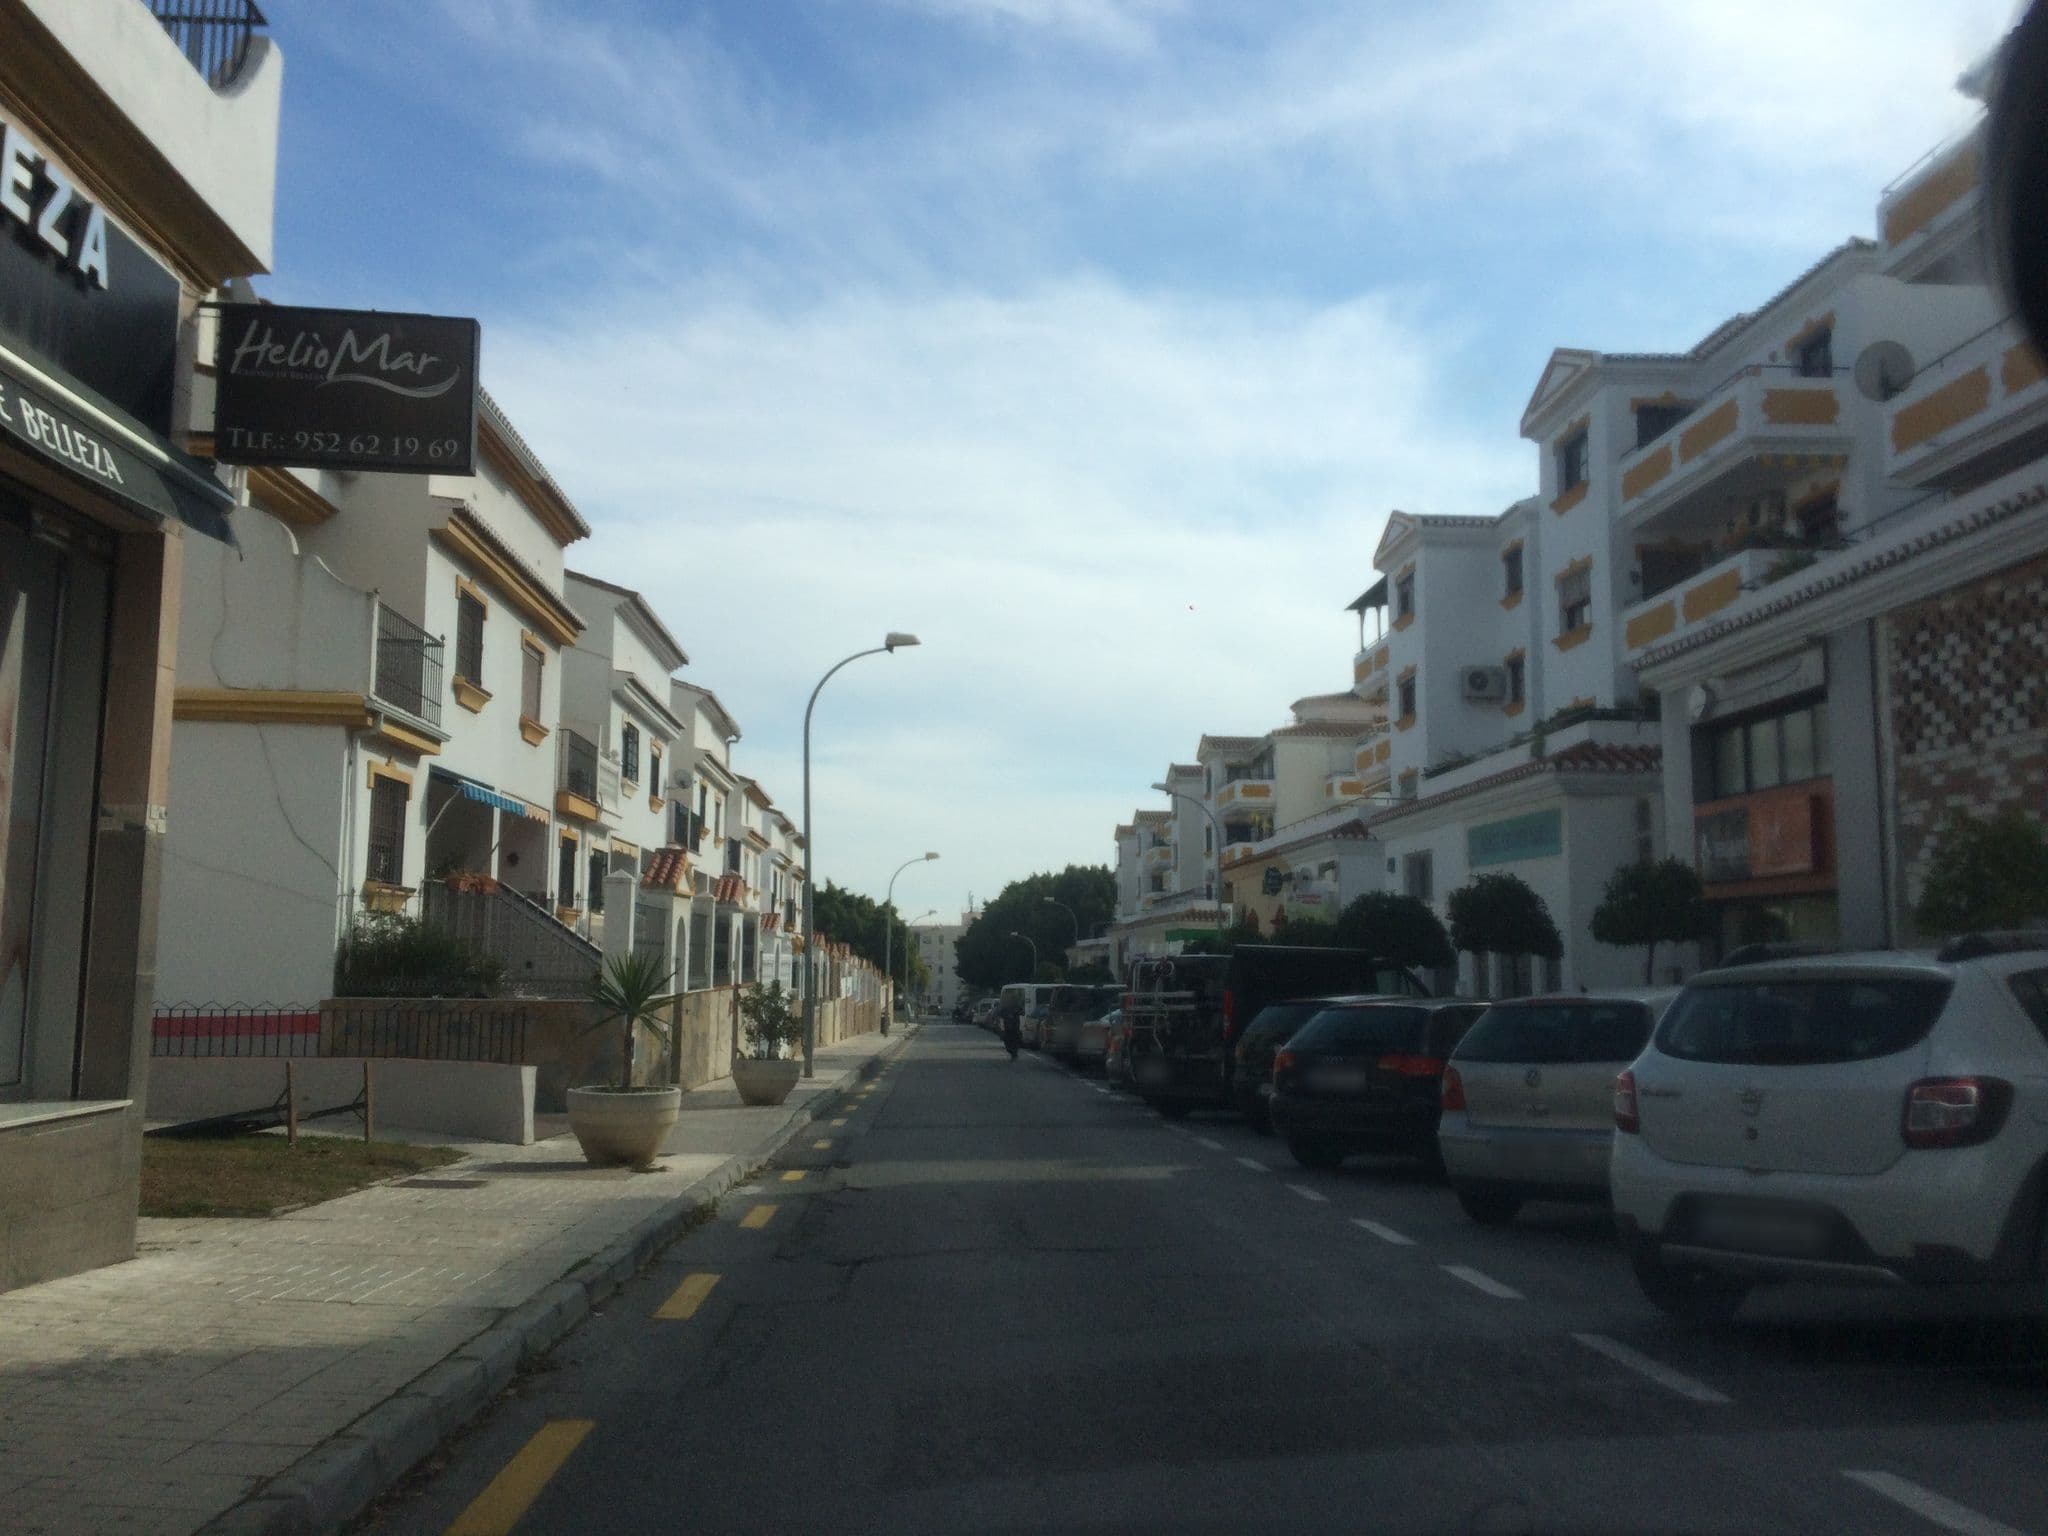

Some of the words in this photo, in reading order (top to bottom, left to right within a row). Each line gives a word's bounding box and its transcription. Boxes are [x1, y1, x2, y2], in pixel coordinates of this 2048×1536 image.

[19, 397, 124, 485] BELLEZA
[295, 431, 340, 453] 952
[349, 434, 380, 455] 62
[392, 436, 420, 457] 19
[428, 438, 458, 459] 69
